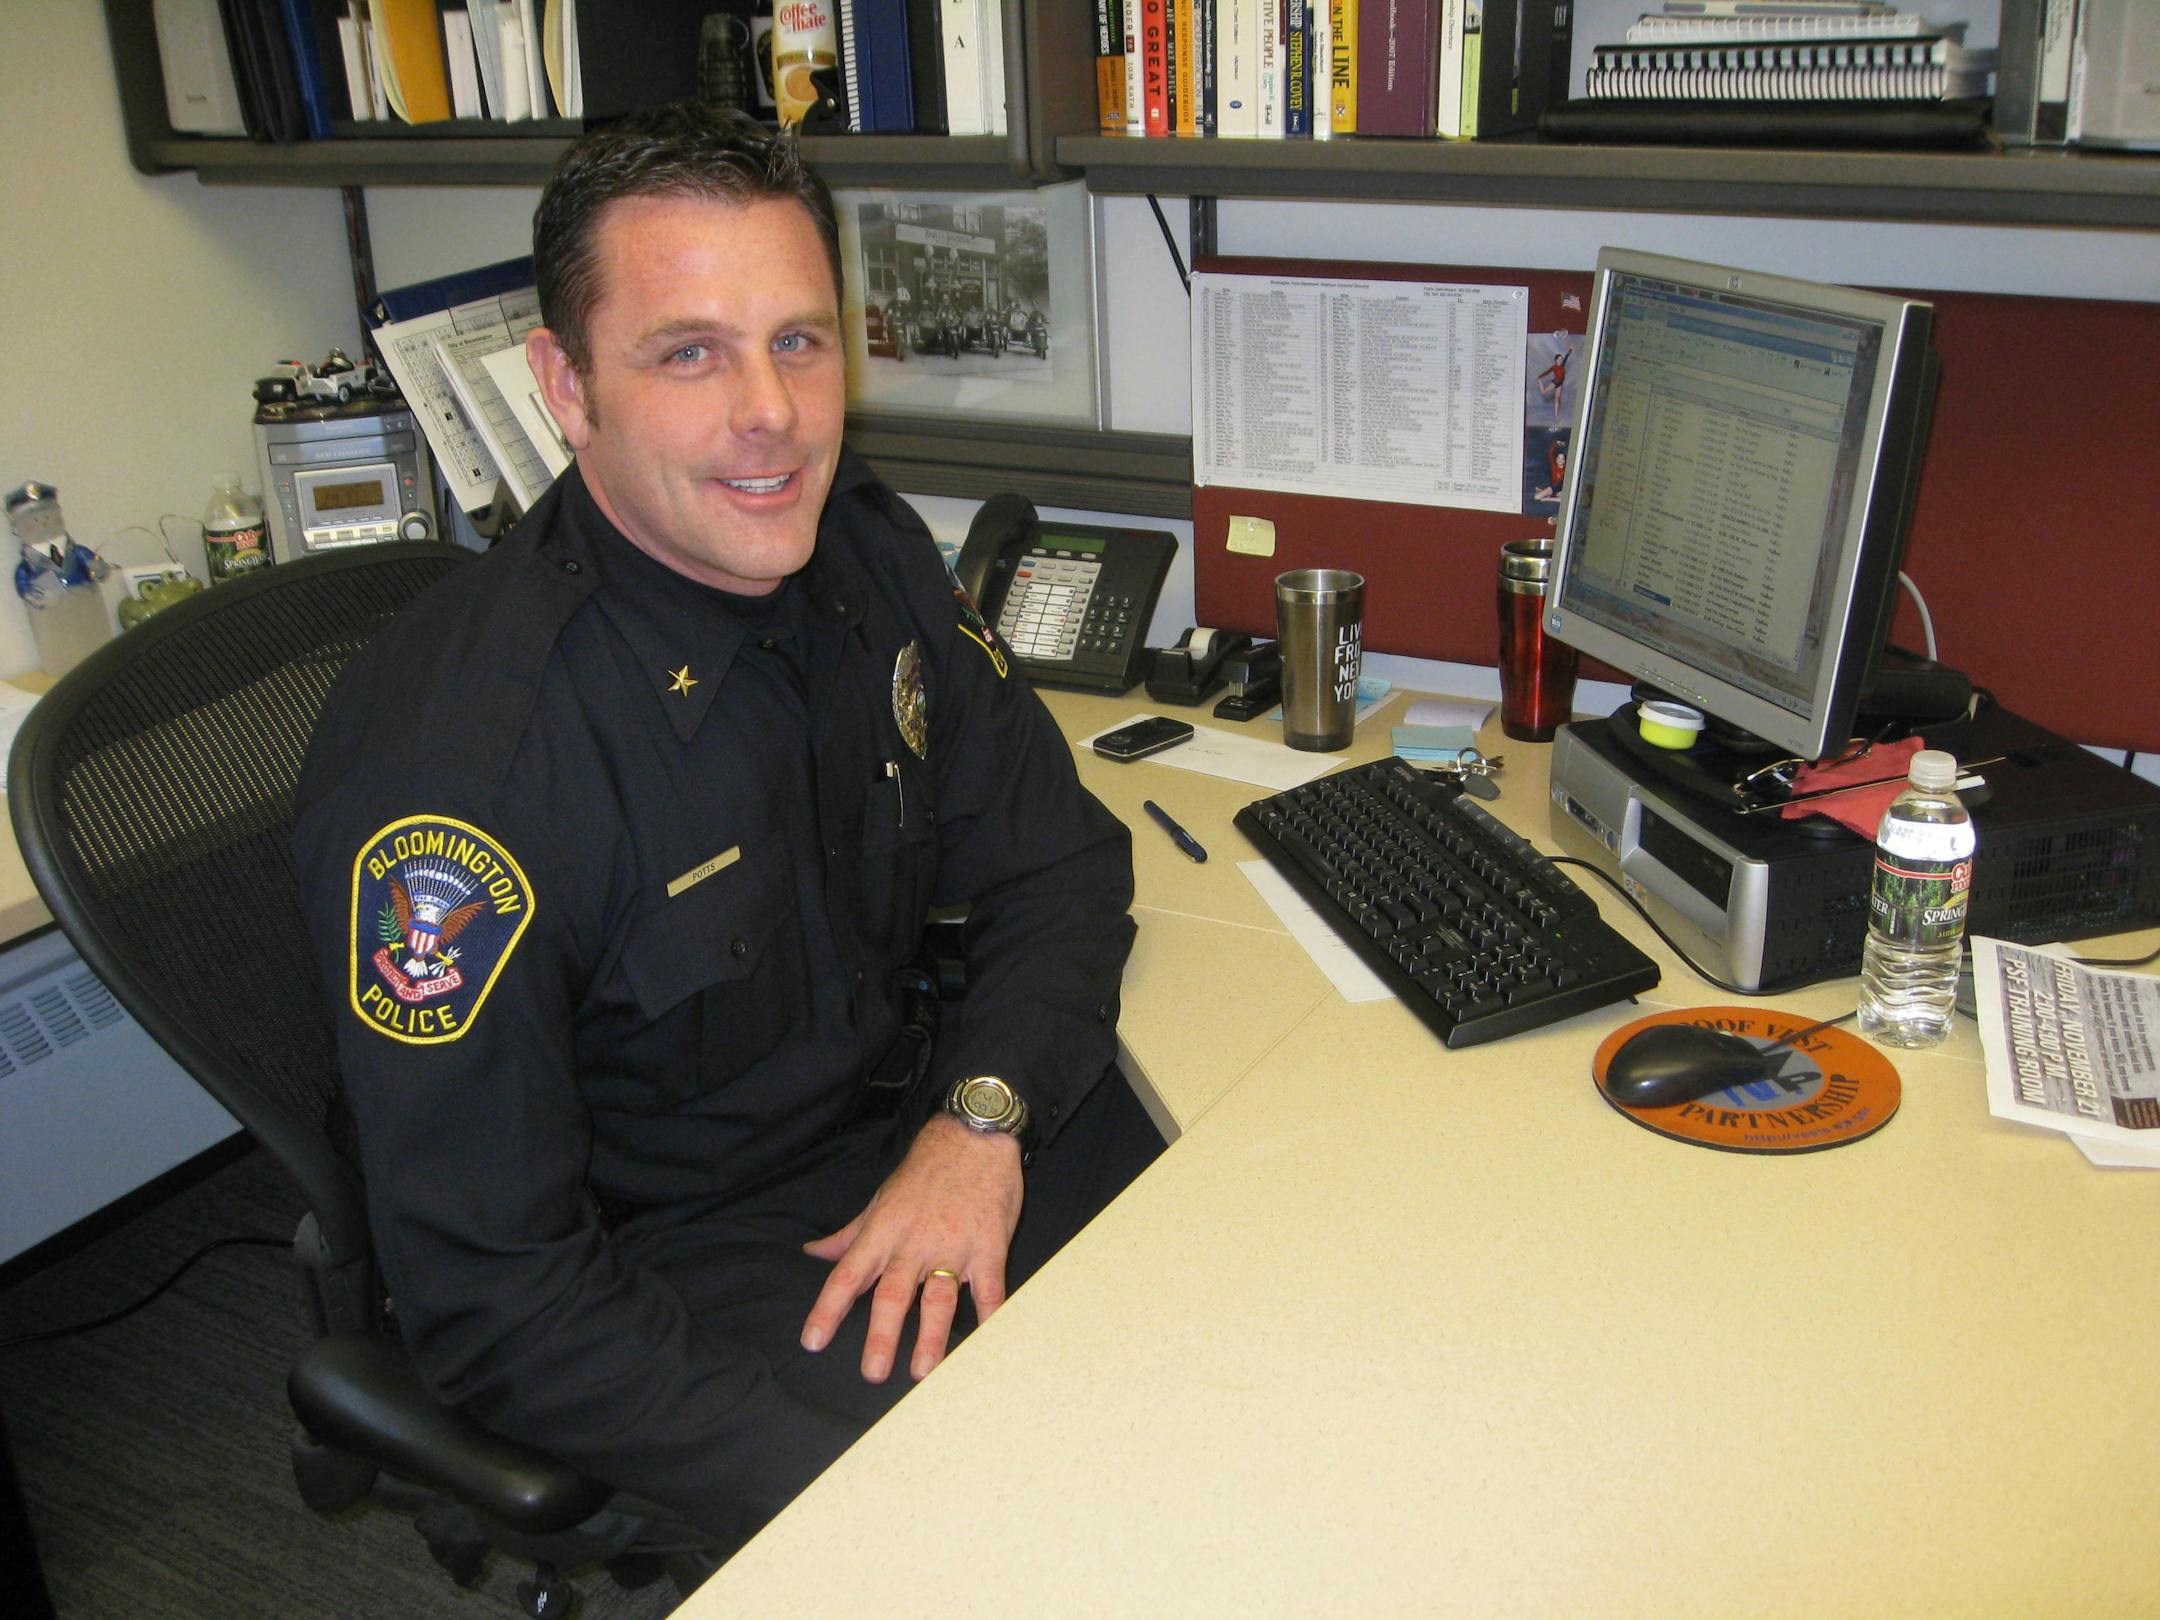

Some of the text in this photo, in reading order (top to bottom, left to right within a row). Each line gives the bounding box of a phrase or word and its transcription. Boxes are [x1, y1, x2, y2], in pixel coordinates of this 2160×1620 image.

[780, 2, 817, 26] Coffee
[792, 14, 827, 32] mate
[1099, 14, 1108, 23] OF
[953, 34, 965, 49] A
[1100, 25, 1110, 54] HEROES
[1332, 18, 1343, 42] THE
[1148, 26, 1161, 96] GREAT
[1264, 28, 1274, 69] PEOPLE
[1290, 31, 1303, 71] STEPHEN
[1332, 45, 1350, 89] LINE
[1387, 60, 1396, 91] Edition
[1182, 72, 1190, 124] GUIDEBOOK
[1290, 80, 1303, 110] COVEY
[367, 830, 522, 916] BLOOMINGTON
[692, 862, 716, 881] POTTS
[400, 985, 421, 999] AND
[426, 972, 460, 993] SERVE
[361, 983, 457, 1033] POLICE
[1681, 1018, 1755, 1033] OOF
[2005, 957, 2047, 1106] PSF TRAINING ROOM
[2033, 990, 2069, 1081] 2:00-4:00 P.M.
[2061, 1018, 2098, 1098] NOVEMBER
[1677, 1073, 1860, 1130] PARTNERSHIP
[2077, 1099, 2101, 1118] 21
